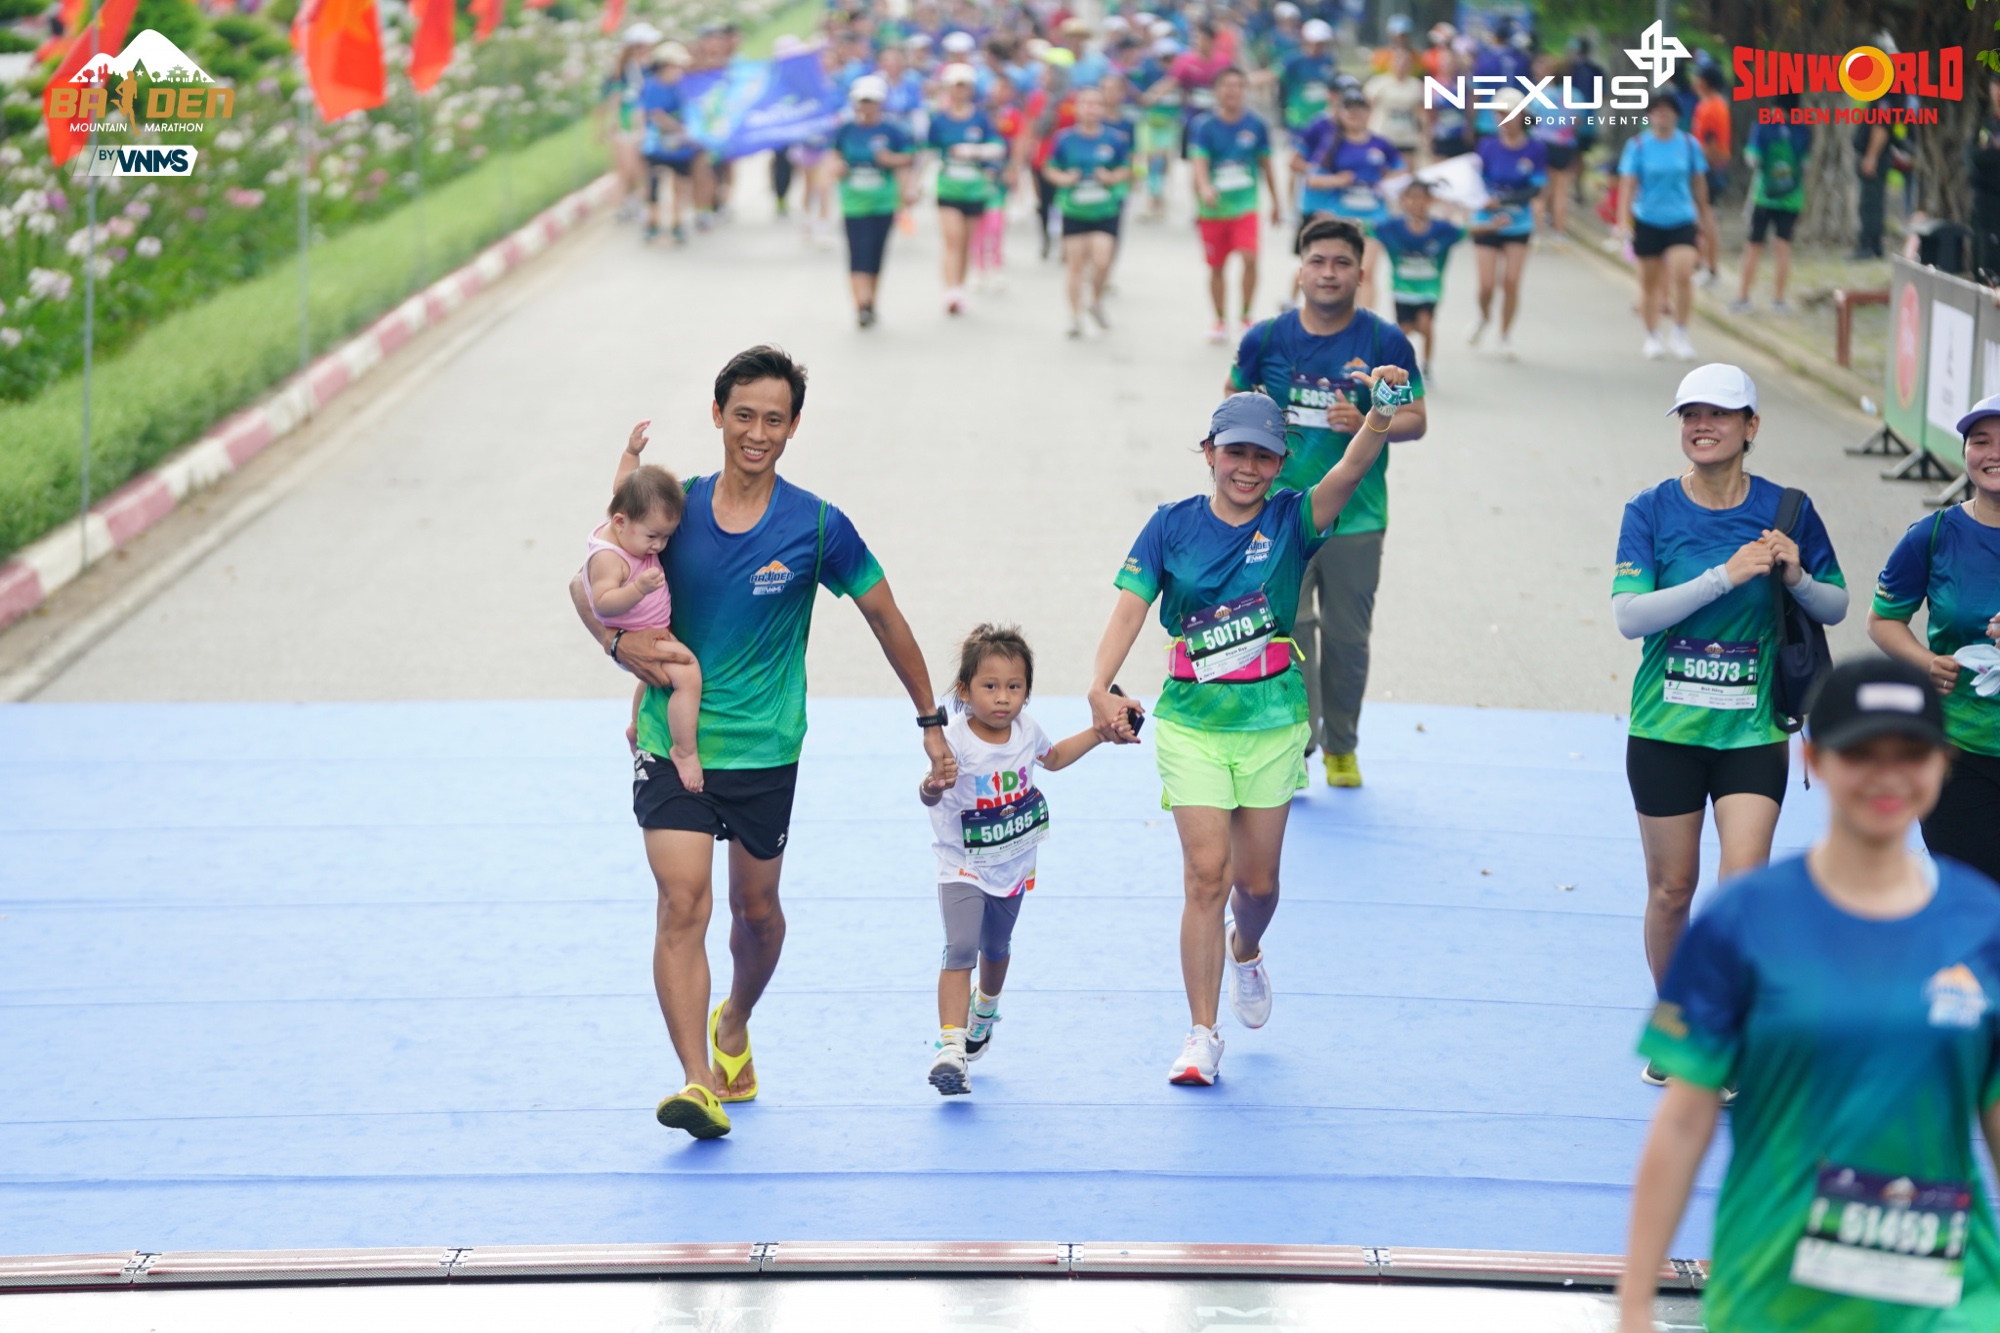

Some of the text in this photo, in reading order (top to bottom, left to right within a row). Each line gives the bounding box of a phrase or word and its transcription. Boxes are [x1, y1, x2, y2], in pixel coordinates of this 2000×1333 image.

[1202, 616, 1255, 650] 50179
[1684, 657, 1740, 682] 50373
[974, 766, 1028, 796] KIDS
[981, 810, 1034, 843] 50485
